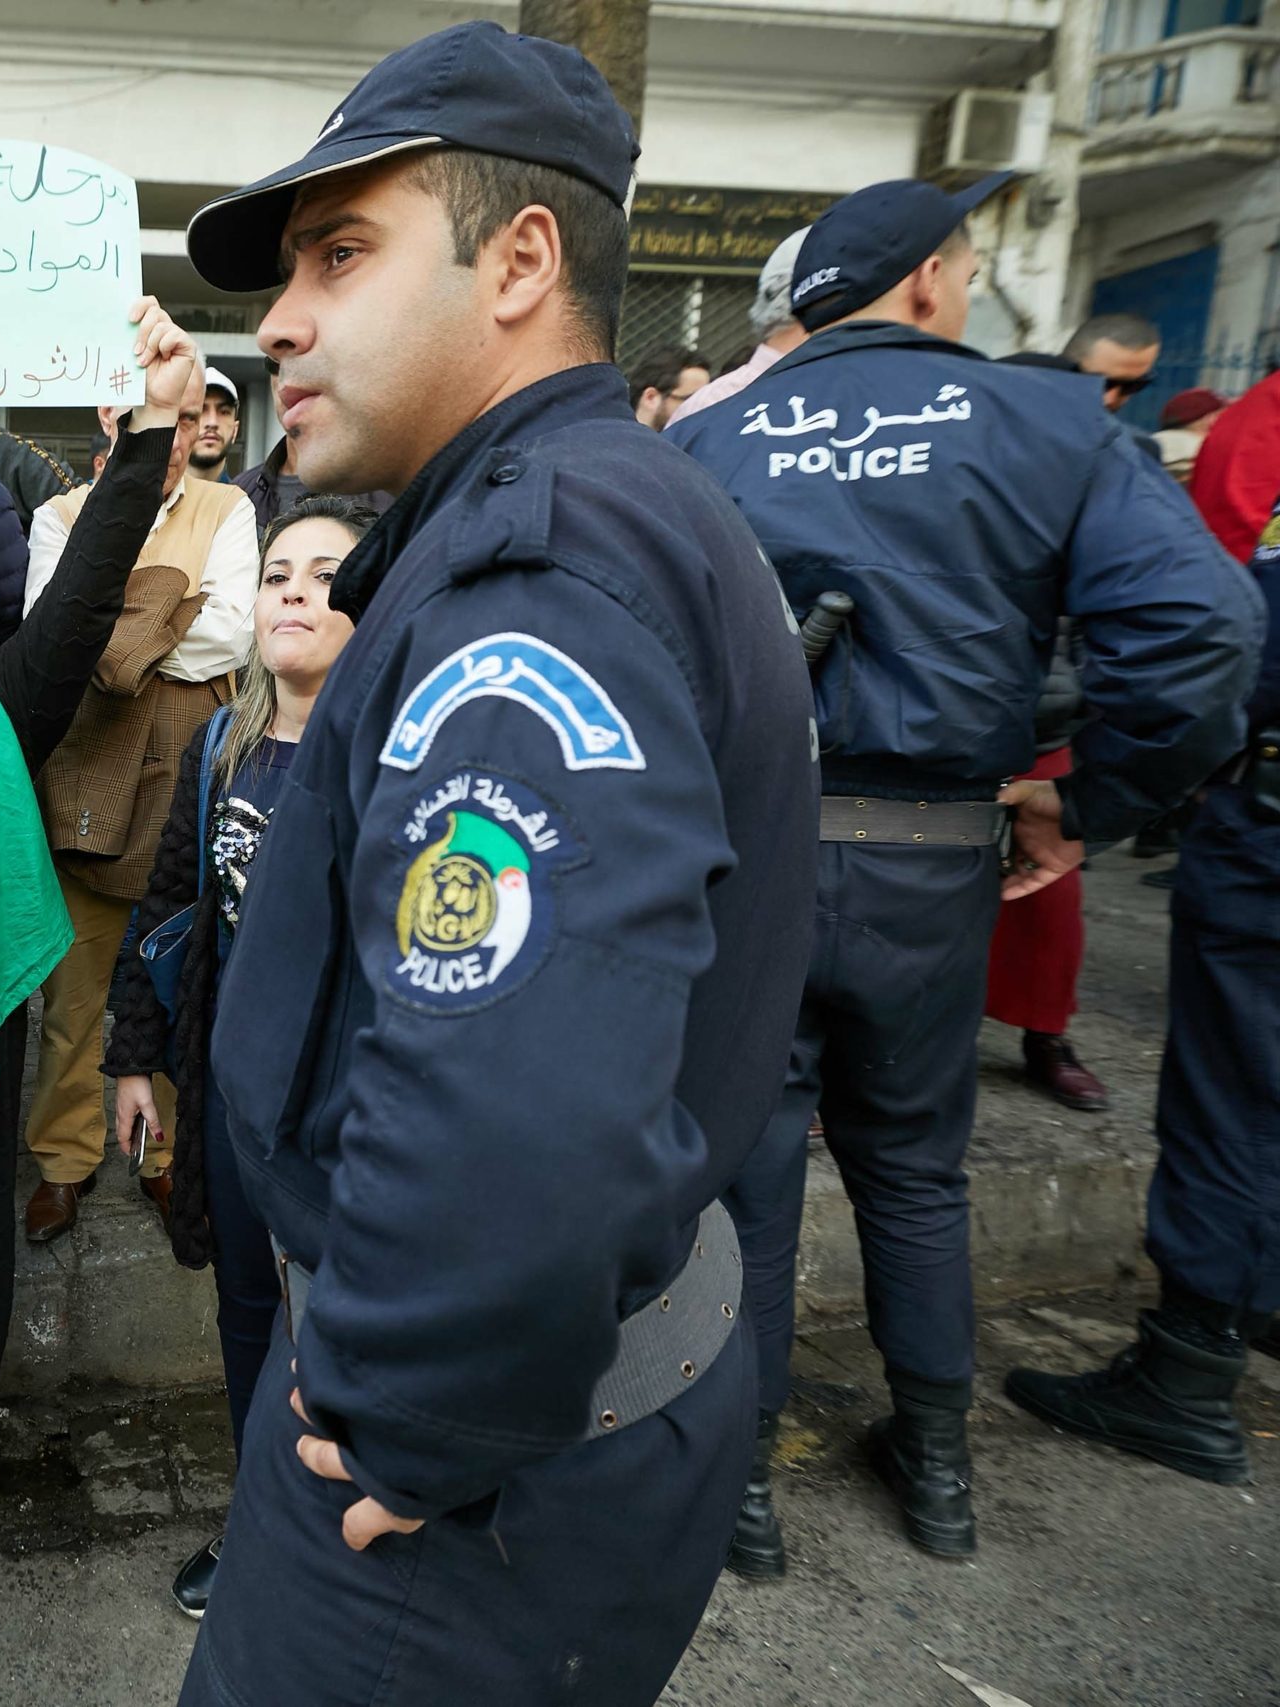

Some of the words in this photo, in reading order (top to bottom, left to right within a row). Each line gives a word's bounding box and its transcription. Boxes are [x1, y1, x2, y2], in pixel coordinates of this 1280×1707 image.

[792, 266, 841, 303] POLICE
[739, 383, 972, 449] شرطة
[768, 441, 932, 482] POLICE
[471, 777, 561, 853] الشرطة
[395, 945, 488, 994] POLICE
